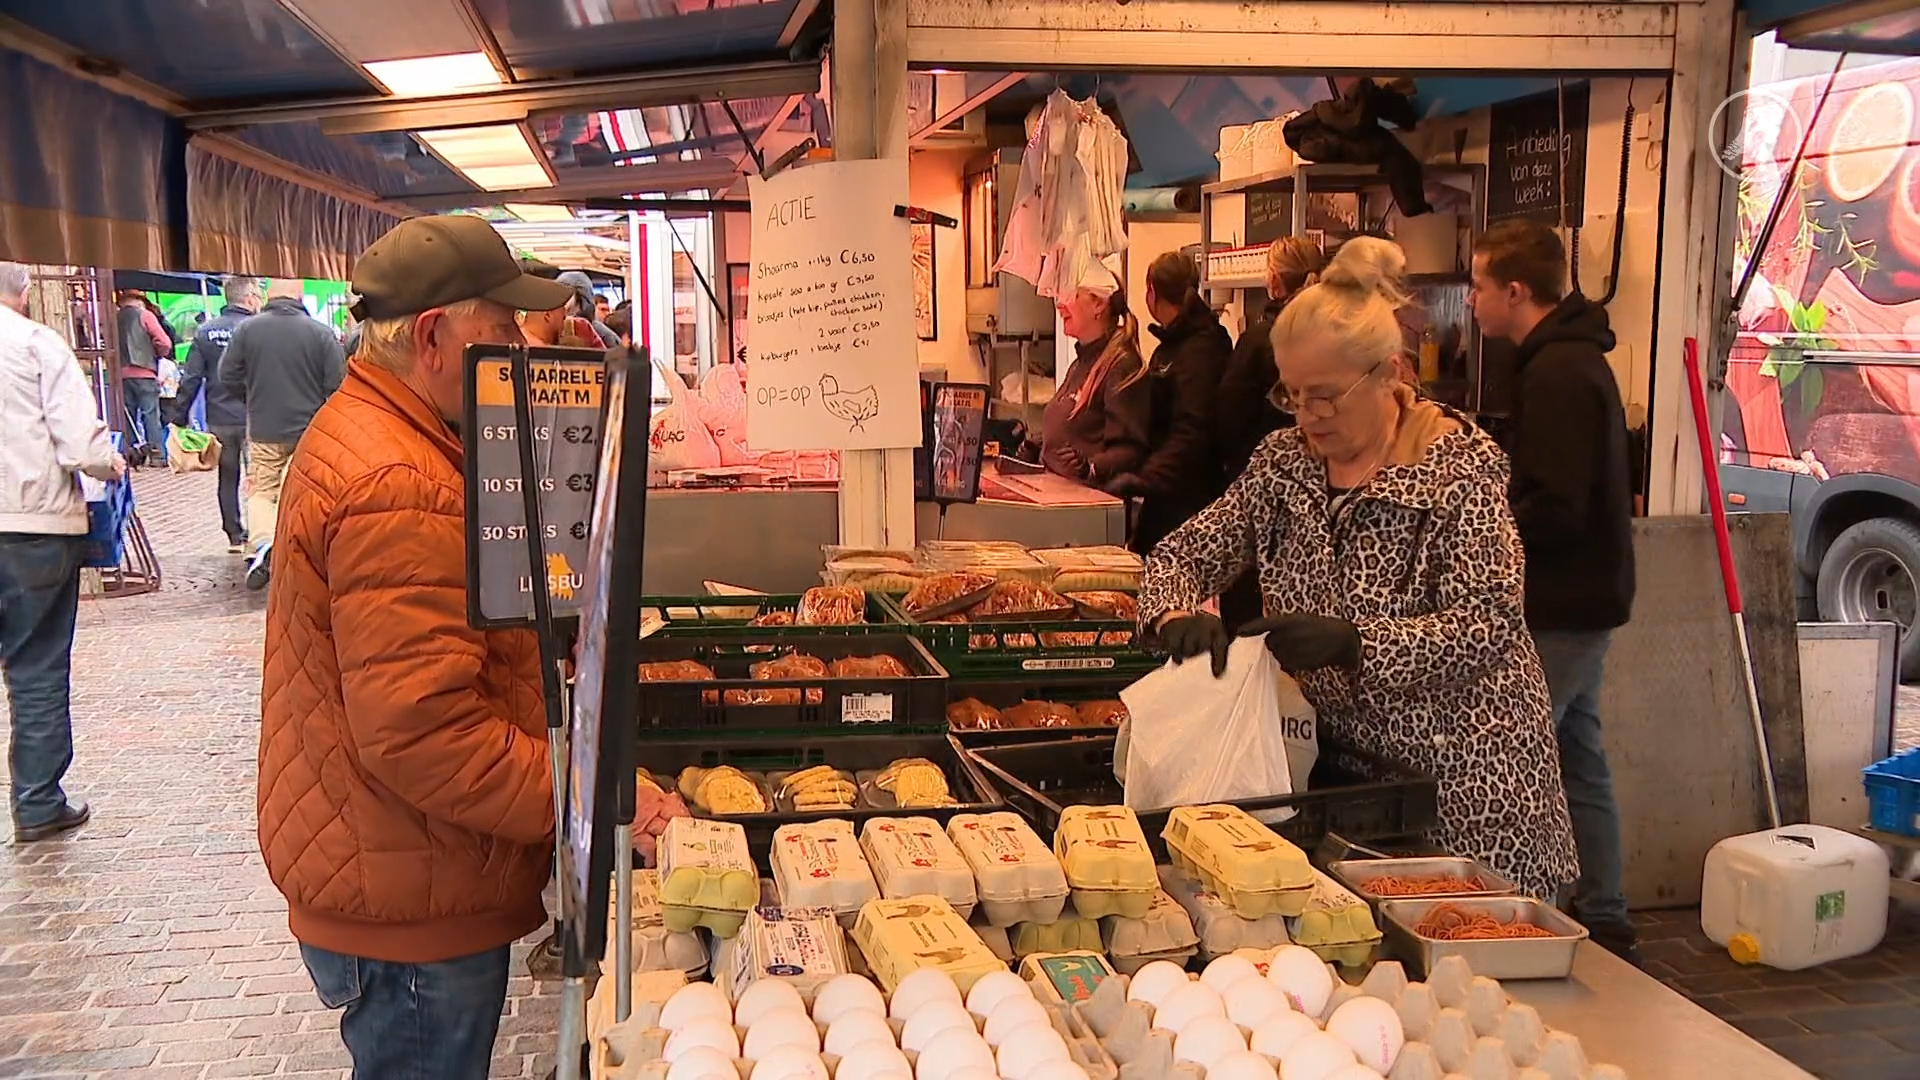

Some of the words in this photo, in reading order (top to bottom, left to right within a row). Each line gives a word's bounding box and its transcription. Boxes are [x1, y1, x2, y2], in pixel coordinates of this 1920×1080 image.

[1511, 166, 1529, 181] van
[1532, 160, 1552, 176] deze
[1515, 179, 1551, 204] week:
[499, 367, 591, 384] SHARREL
[575, 389, 590, 404] M
[482, 426, 494, 440] 6
[497, 426, 549, 440] STKS
[483, 479, 501, 492] 10
[505, 478, 555, 492] STKS
[482, 526, 504, 540] 30
[507, 525, 558, 540] STS
